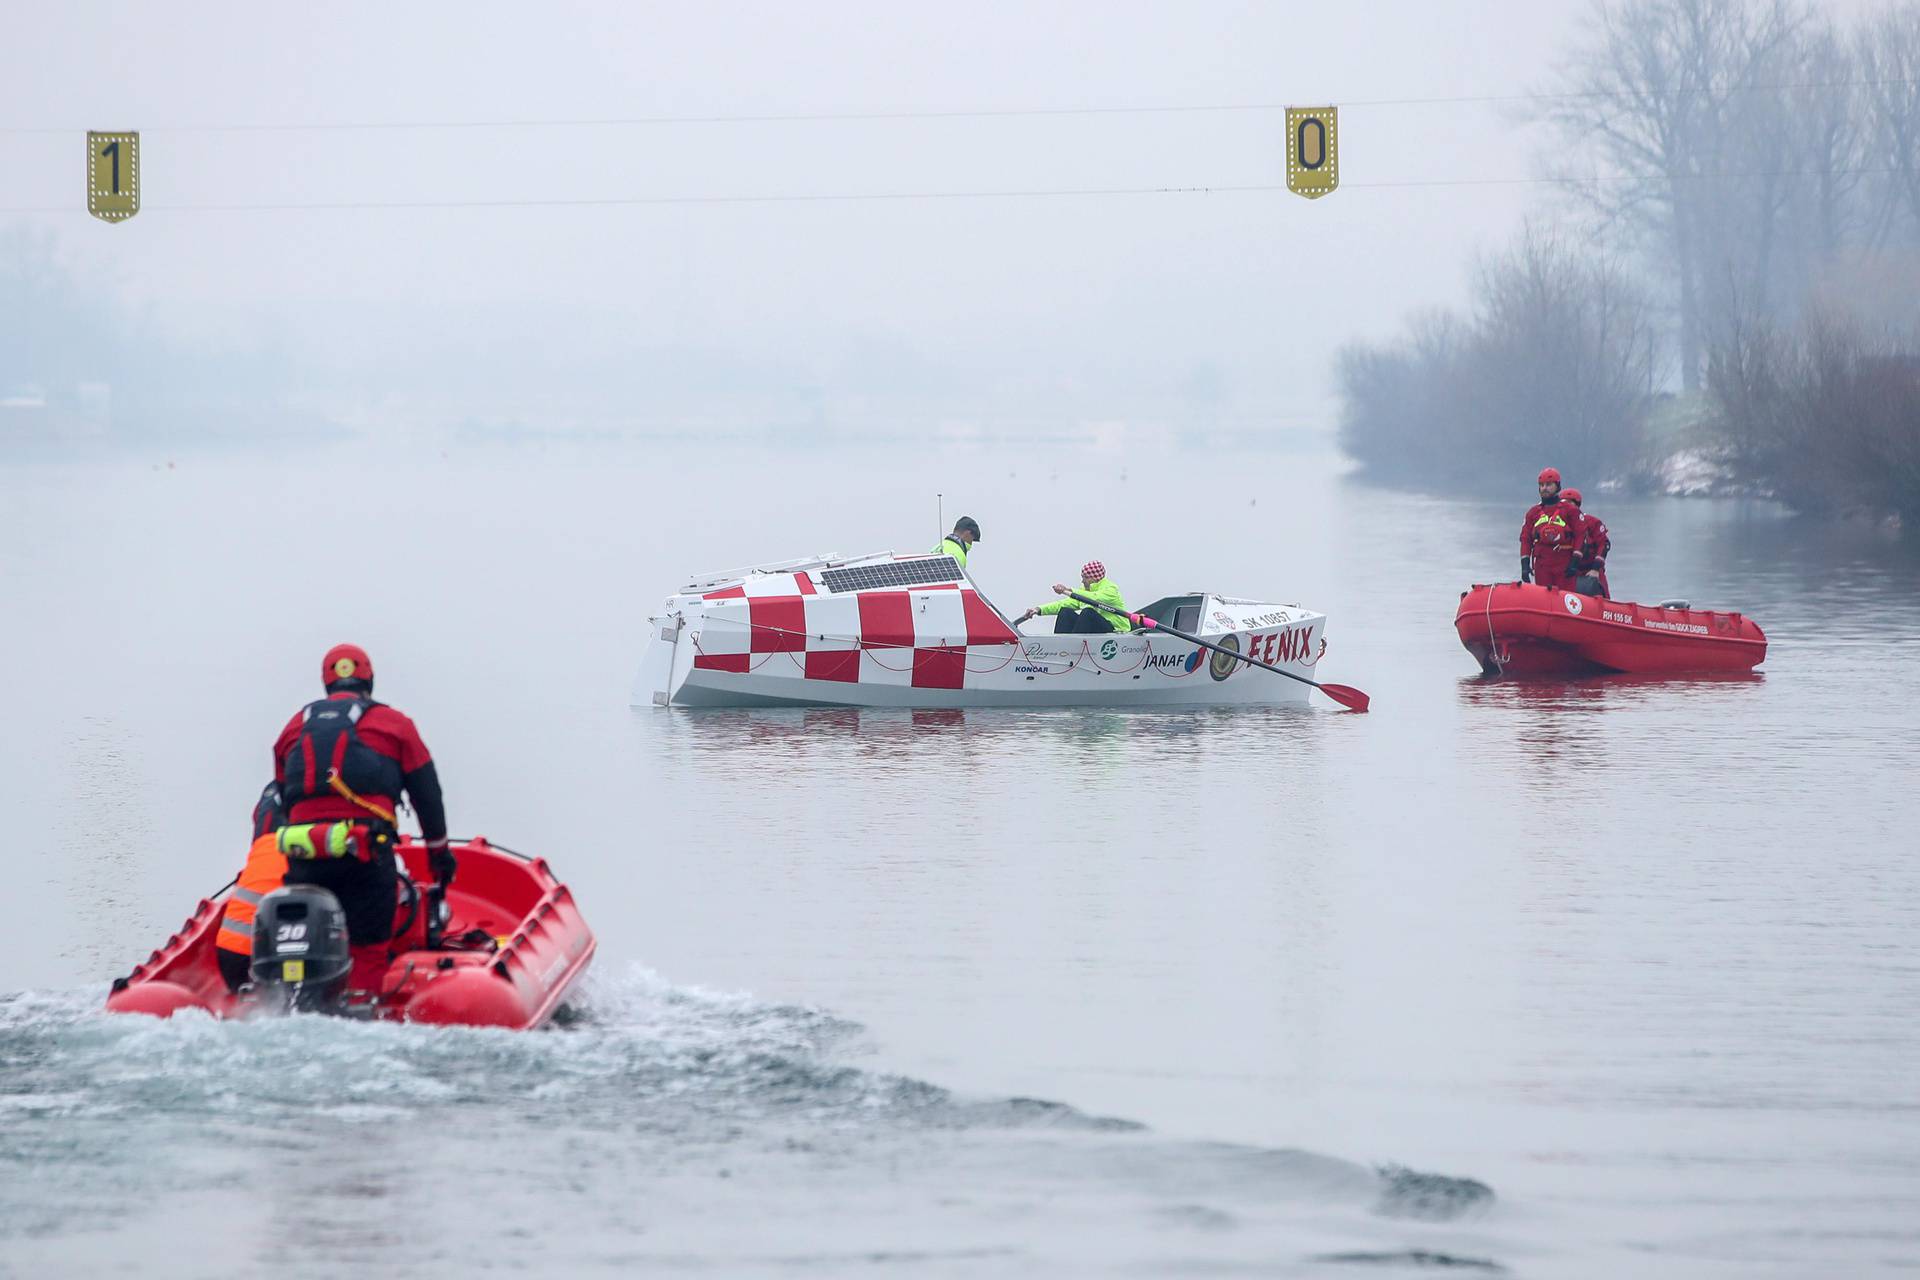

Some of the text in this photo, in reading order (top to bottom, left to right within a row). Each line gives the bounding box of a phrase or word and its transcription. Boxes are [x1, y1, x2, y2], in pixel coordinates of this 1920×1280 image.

[1298, 118, 1326, 169] 0
[102, 141, 119, 194] 1
[1242, 617, 1263, 629] SK
[1259, 611, 1292, 626] 10857
[1246, 625, 1314, 668] FENIX
[1143, 654, 1185, 670] JANAF
[276, 924, 307, 941] 30
